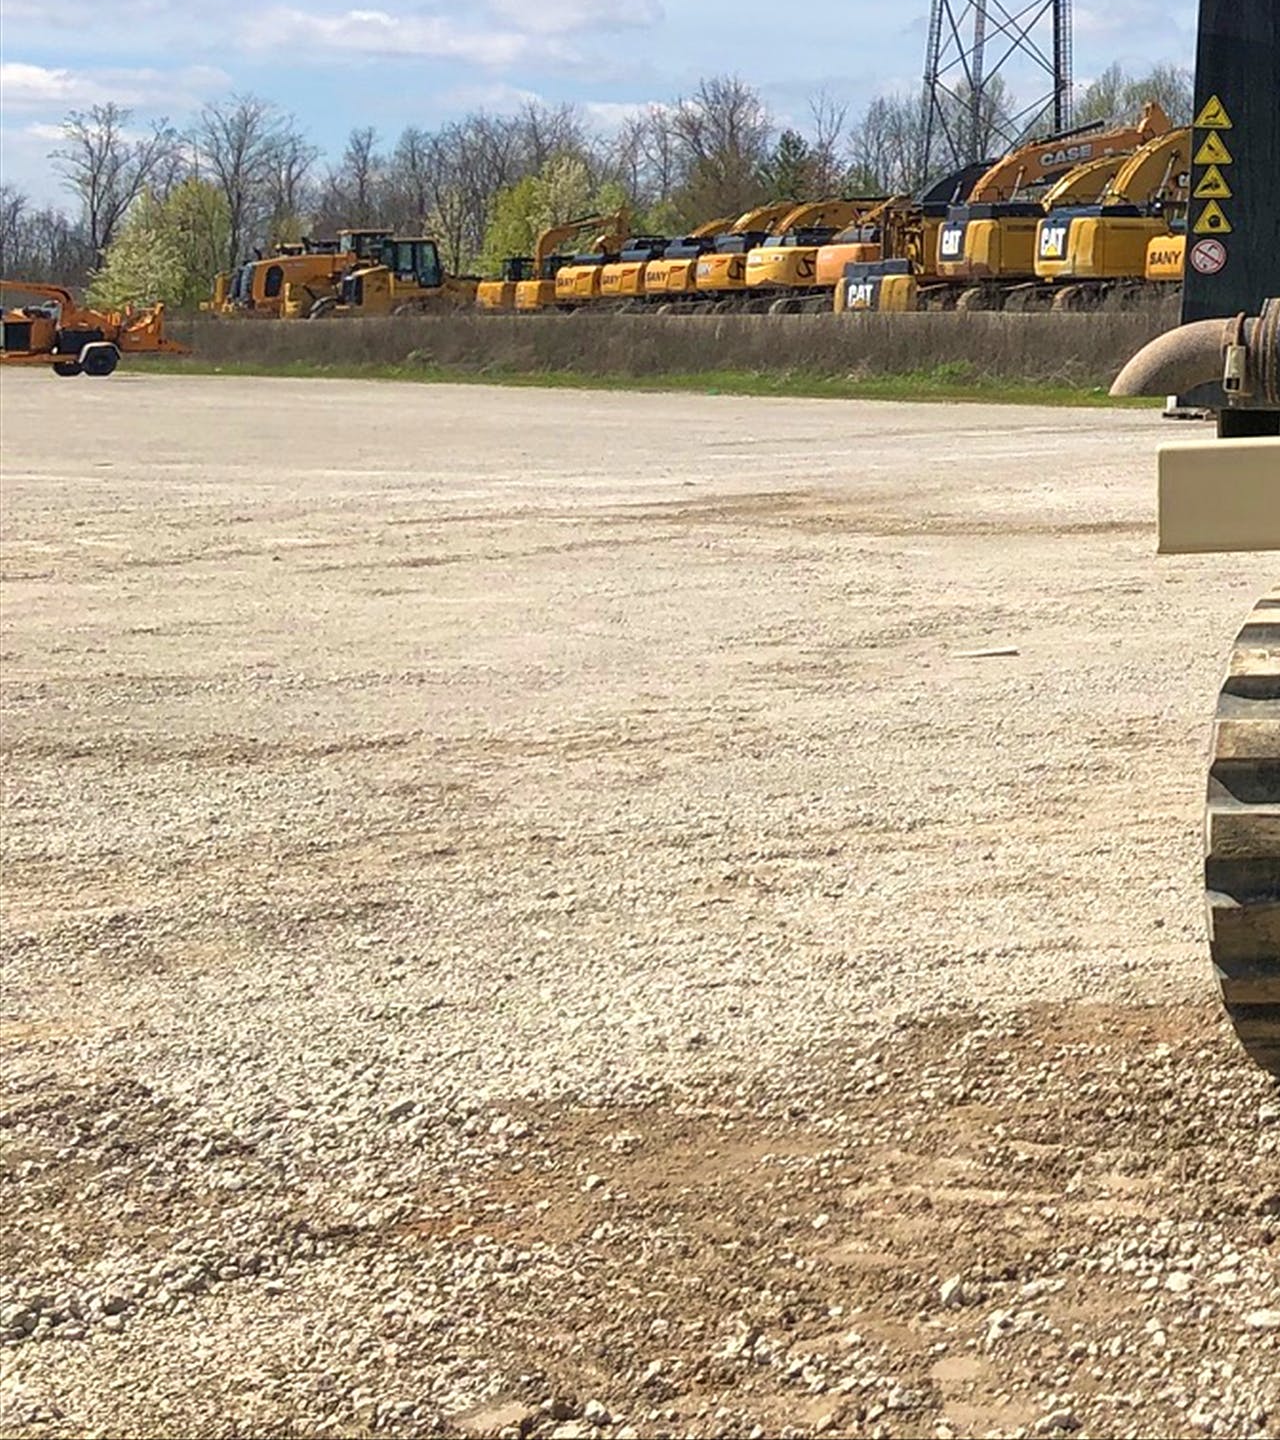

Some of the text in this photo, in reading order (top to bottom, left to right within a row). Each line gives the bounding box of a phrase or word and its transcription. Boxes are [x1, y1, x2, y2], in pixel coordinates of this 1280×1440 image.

[1040, 144, 1092, 166] CASE
[941, 229, 962, 255] CAT
[1041, 227, 1066, 256] CAT
[1150, 251, 1181, 265] SANY
[848, 284, 873, 308] CAT
